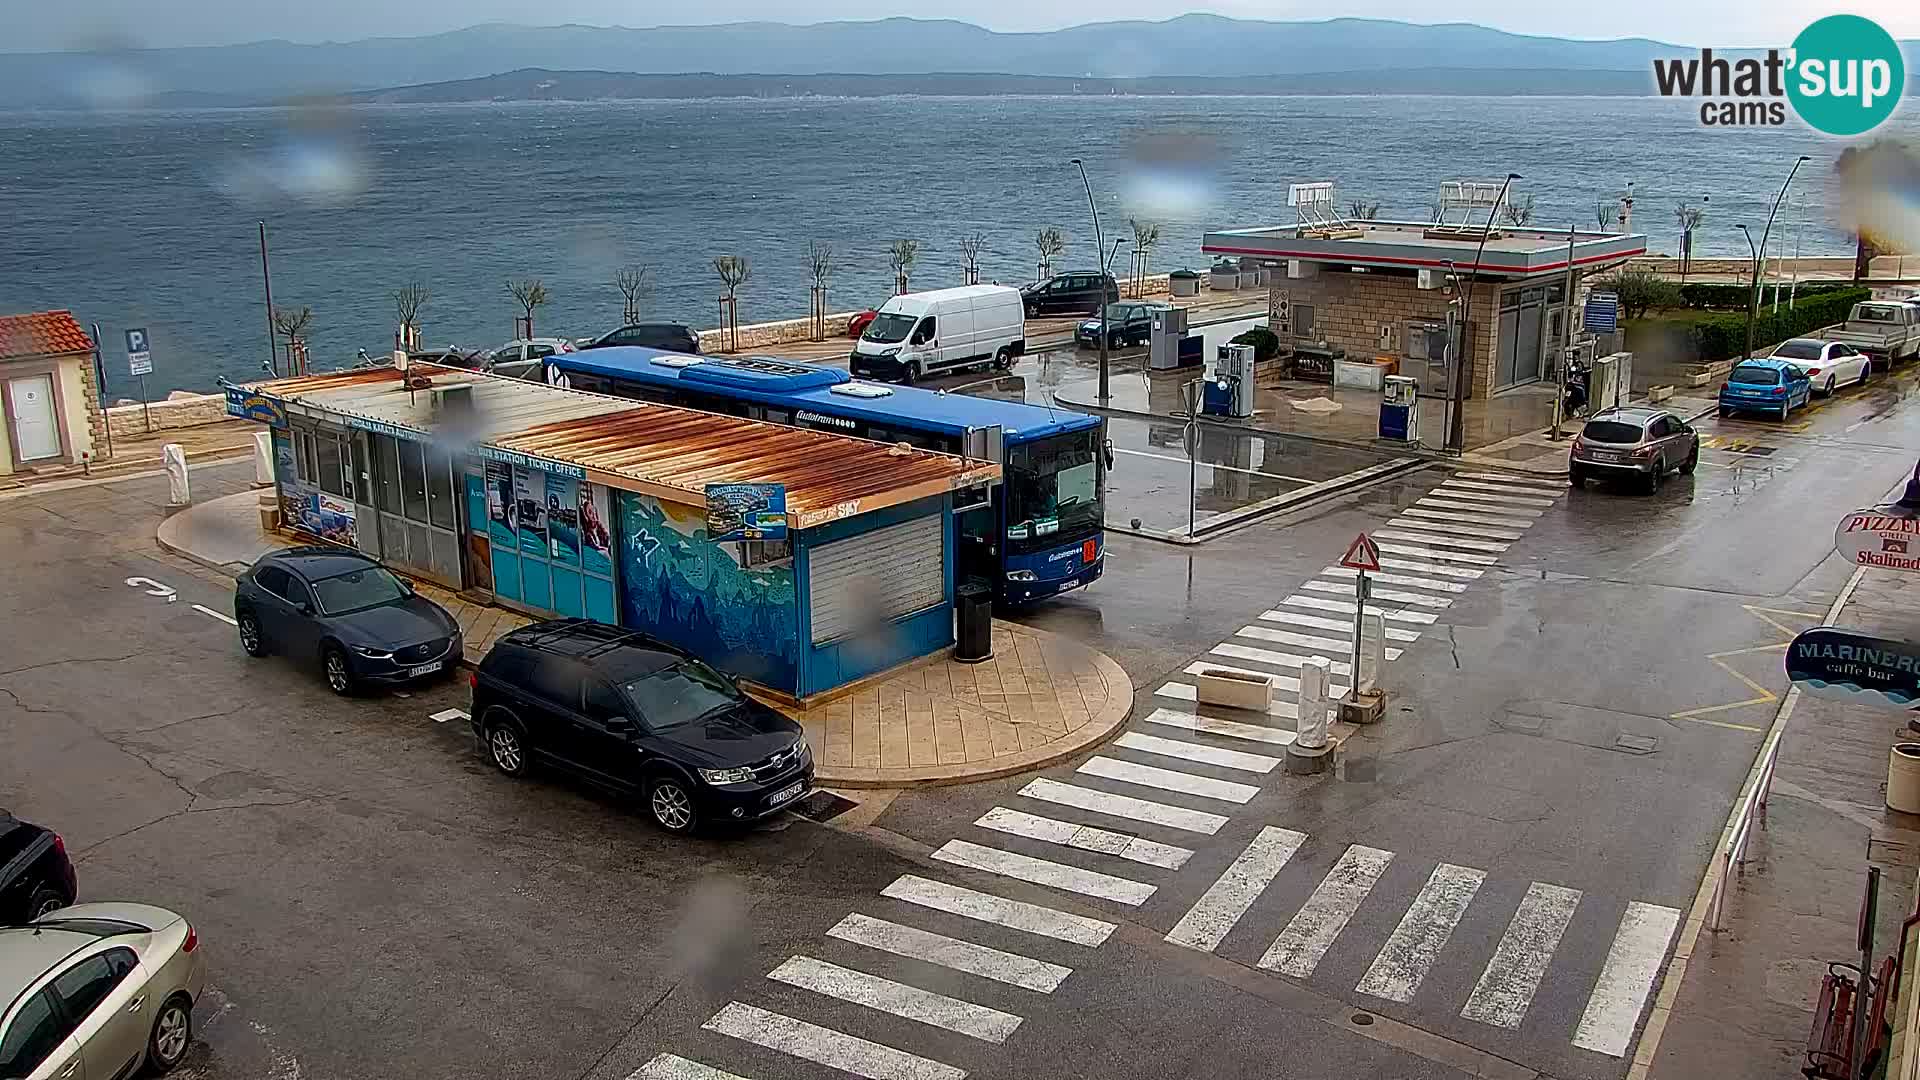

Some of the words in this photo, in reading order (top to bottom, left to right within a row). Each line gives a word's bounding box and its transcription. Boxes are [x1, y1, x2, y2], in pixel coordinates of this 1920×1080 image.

[129, 331, 143, 350] P
[494, 451, 526, 467] STATION
[528, 457, 554, 473] TICKET
[555, 464, 582, 478] OFFICE
[1879, 531, 1912, 541] GRILL
[1826, 663, 1863, 676] caffe
[1867, 666, 1896, 681] bar
